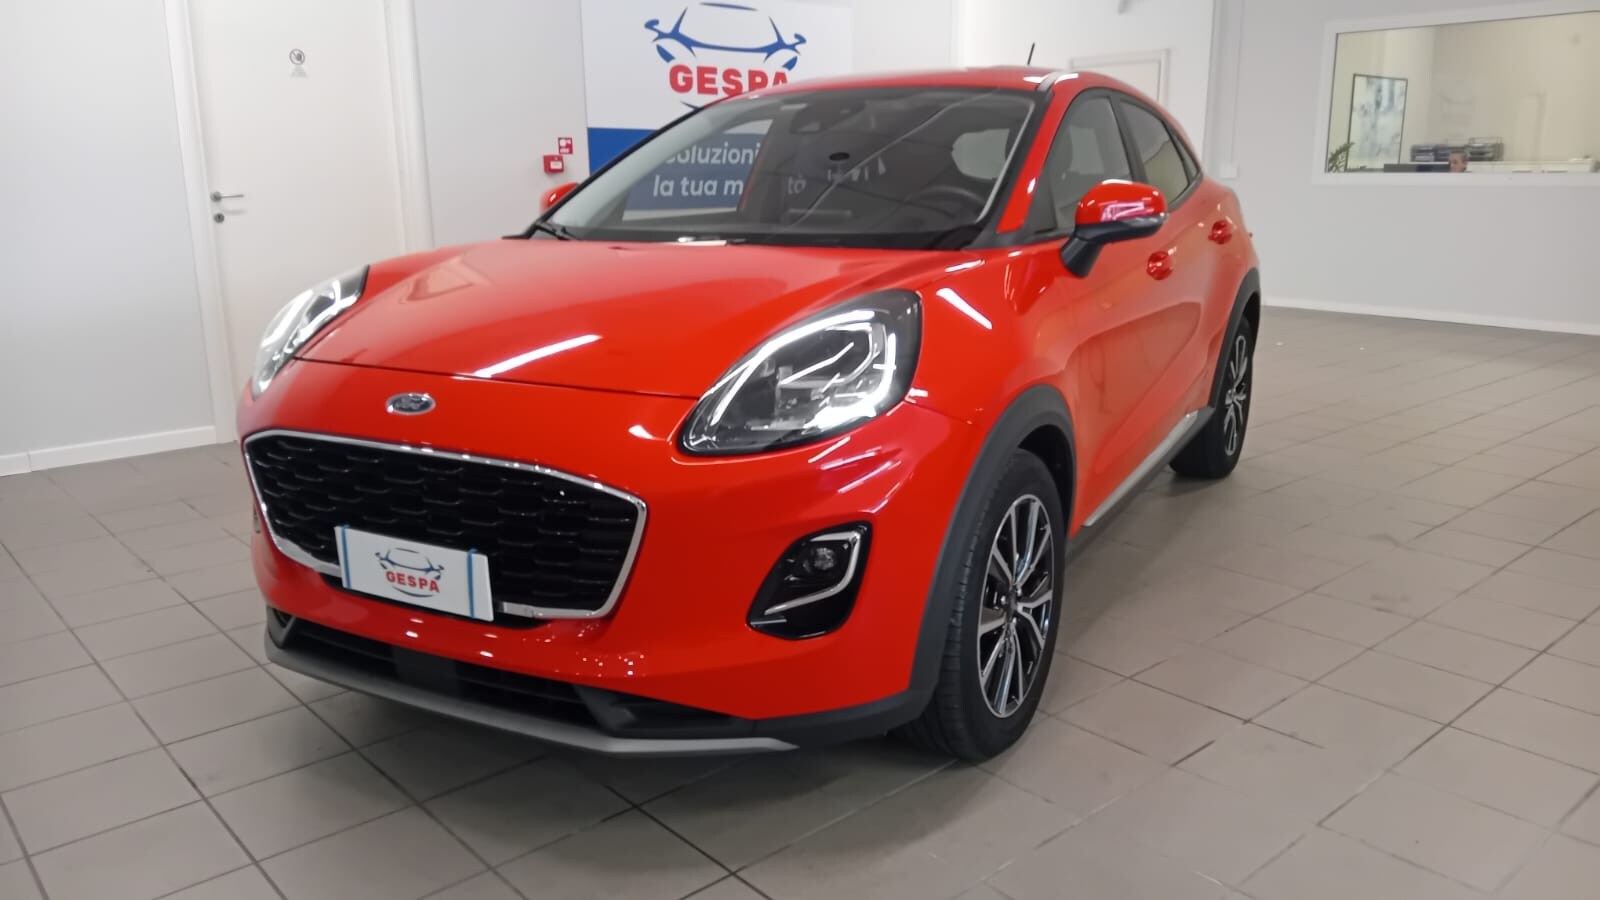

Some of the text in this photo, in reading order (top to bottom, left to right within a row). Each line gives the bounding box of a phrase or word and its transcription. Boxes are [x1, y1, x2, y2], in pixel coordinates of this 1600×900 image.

[666, 142, 760, 165] oluzioni
[653, 175, 674, 197] la
[680, 177, 718, 196] tua
[386, 570, 440, 593] GESPA
